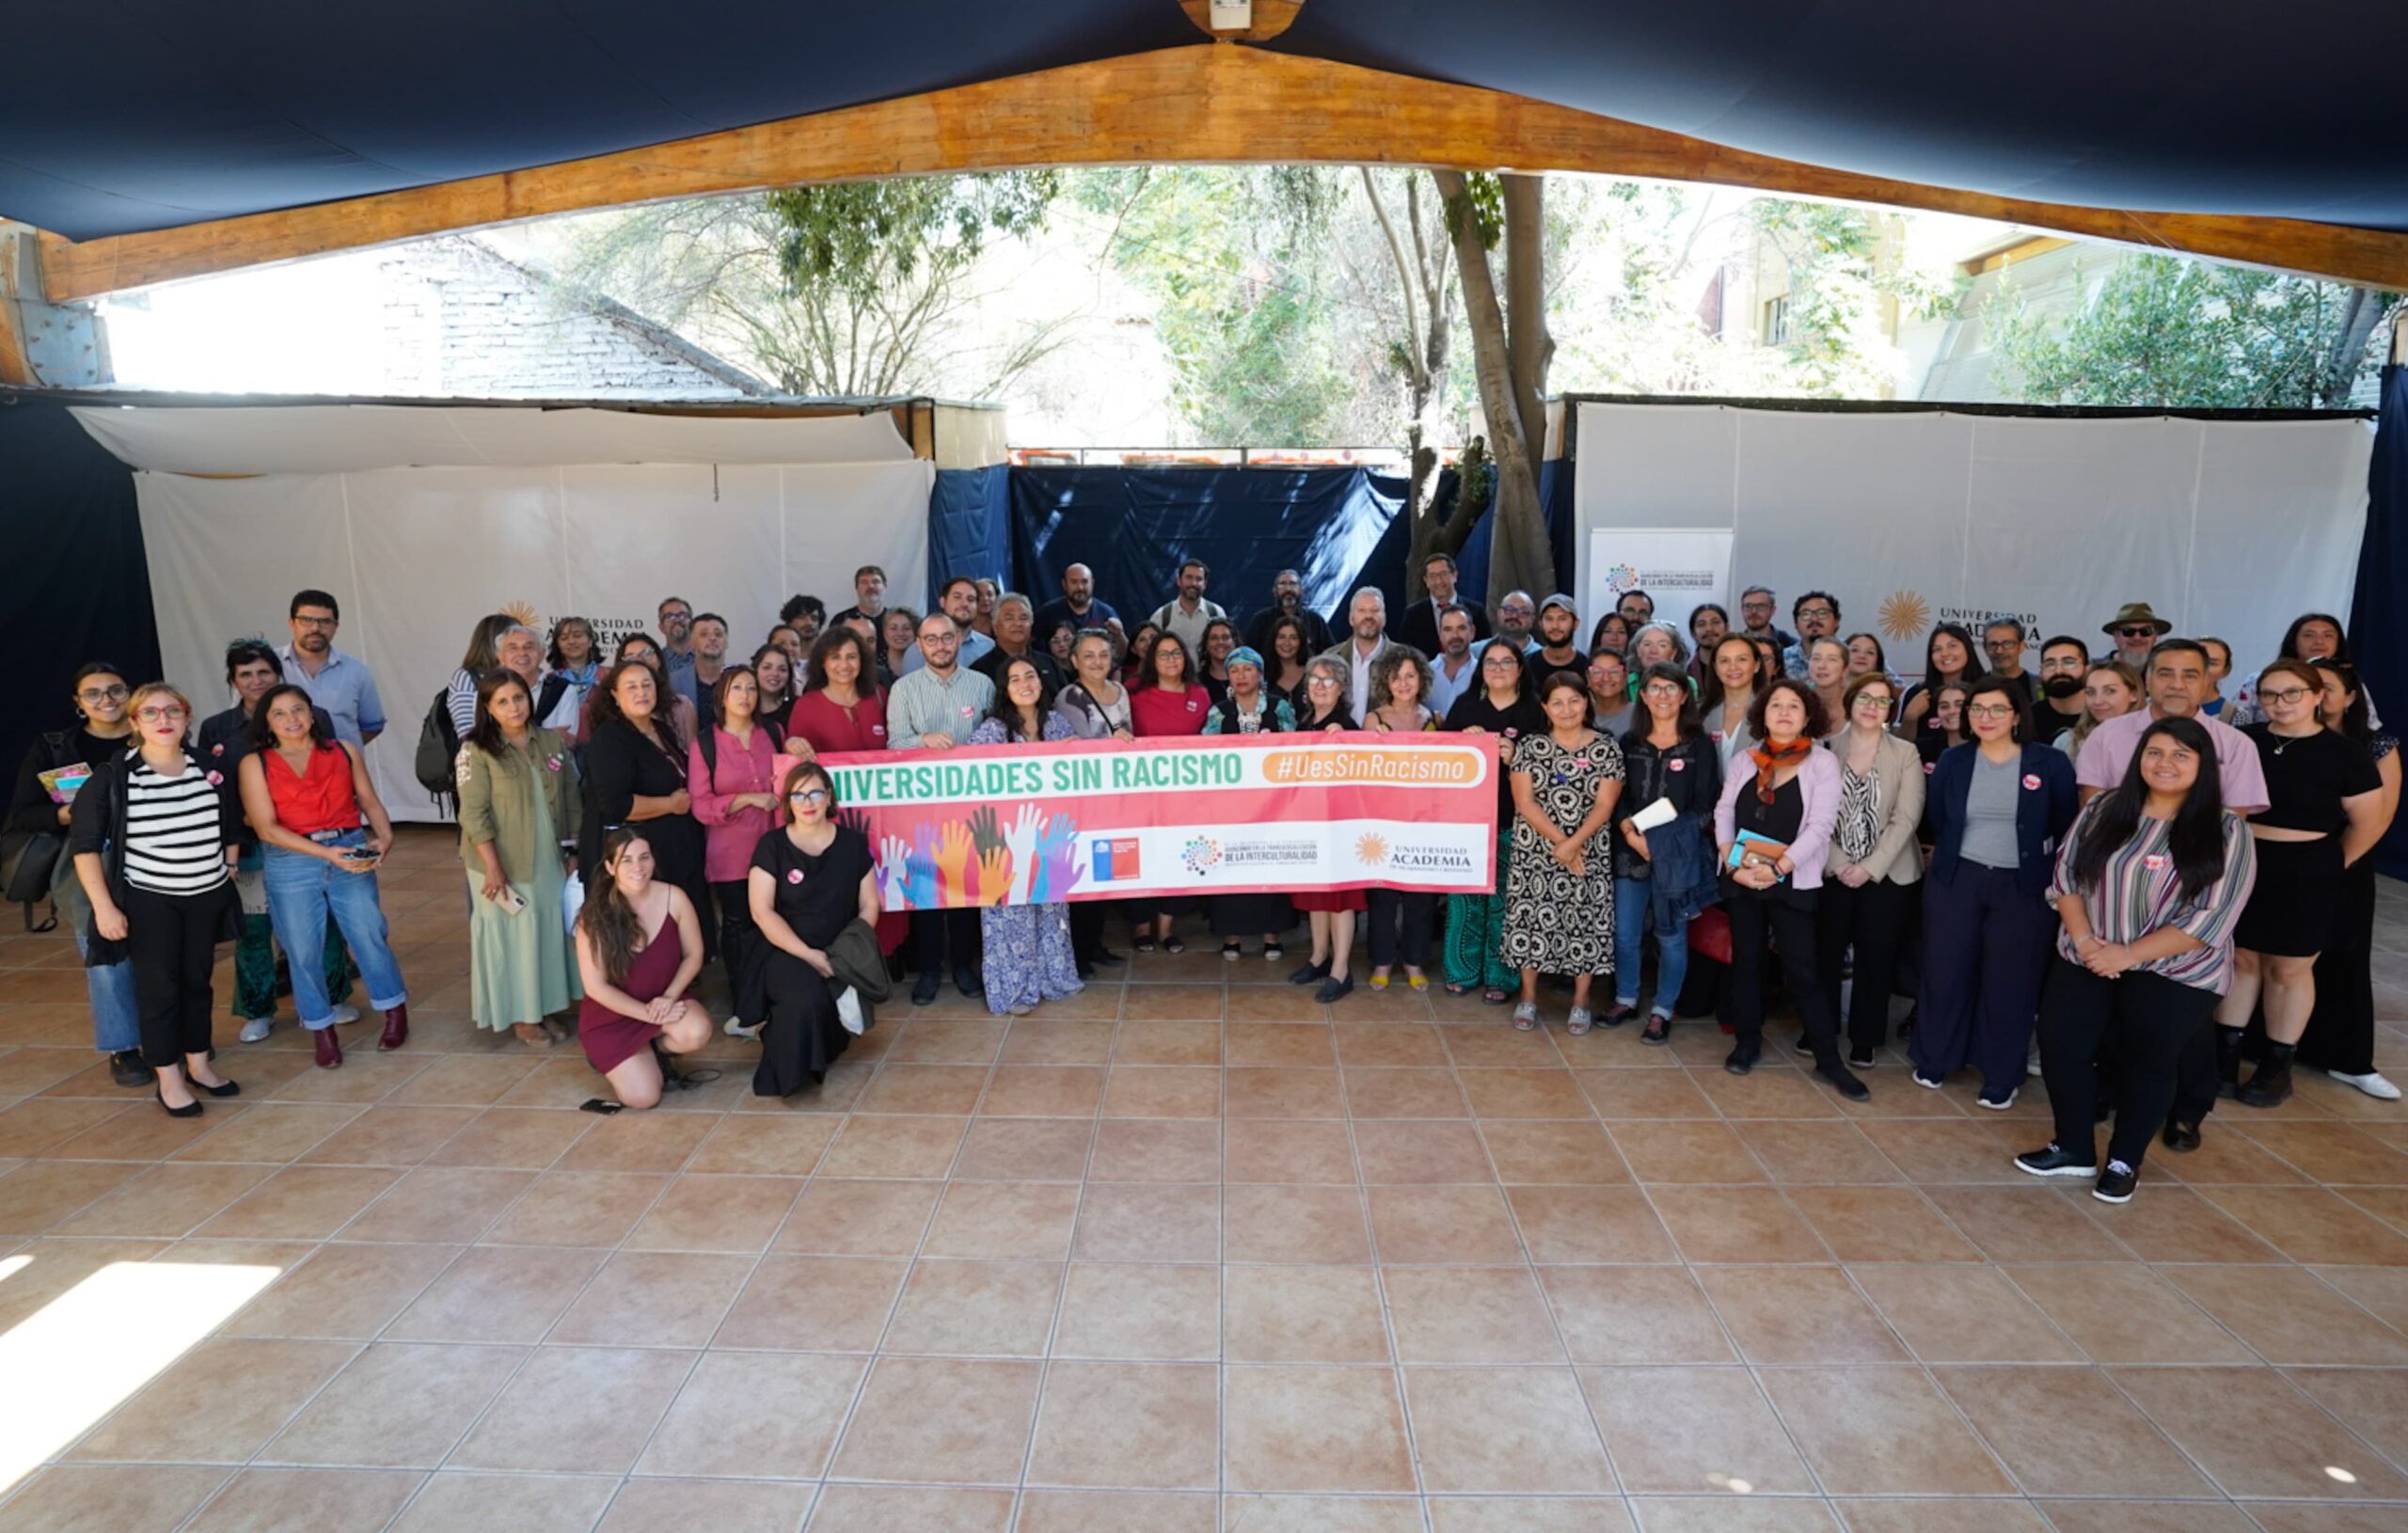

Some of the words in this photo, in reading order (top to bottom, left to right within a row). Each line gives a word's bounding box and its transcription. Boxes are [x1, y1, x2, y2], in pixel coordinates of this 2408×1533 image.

[549, 616, 644, 629] URSIDAD
[1277, 754, 1465, 779] #UesSinRacismo
[833, 762, 1043, 801] IVERSIDADES
[1053, 759, 1101, 791] SIN
[1112, 753, 1242, 788] RACISMO
[1225, 852, 1234, 861] DE
[1236, 852, 1244, 861] LA
[1246, 850, 1318, 861] INTERCULTURALIDAD
[1396, 846, 1466, 855] UNIVERSIDAD
[1391, 854, 1470, 866] ACADEMIA
